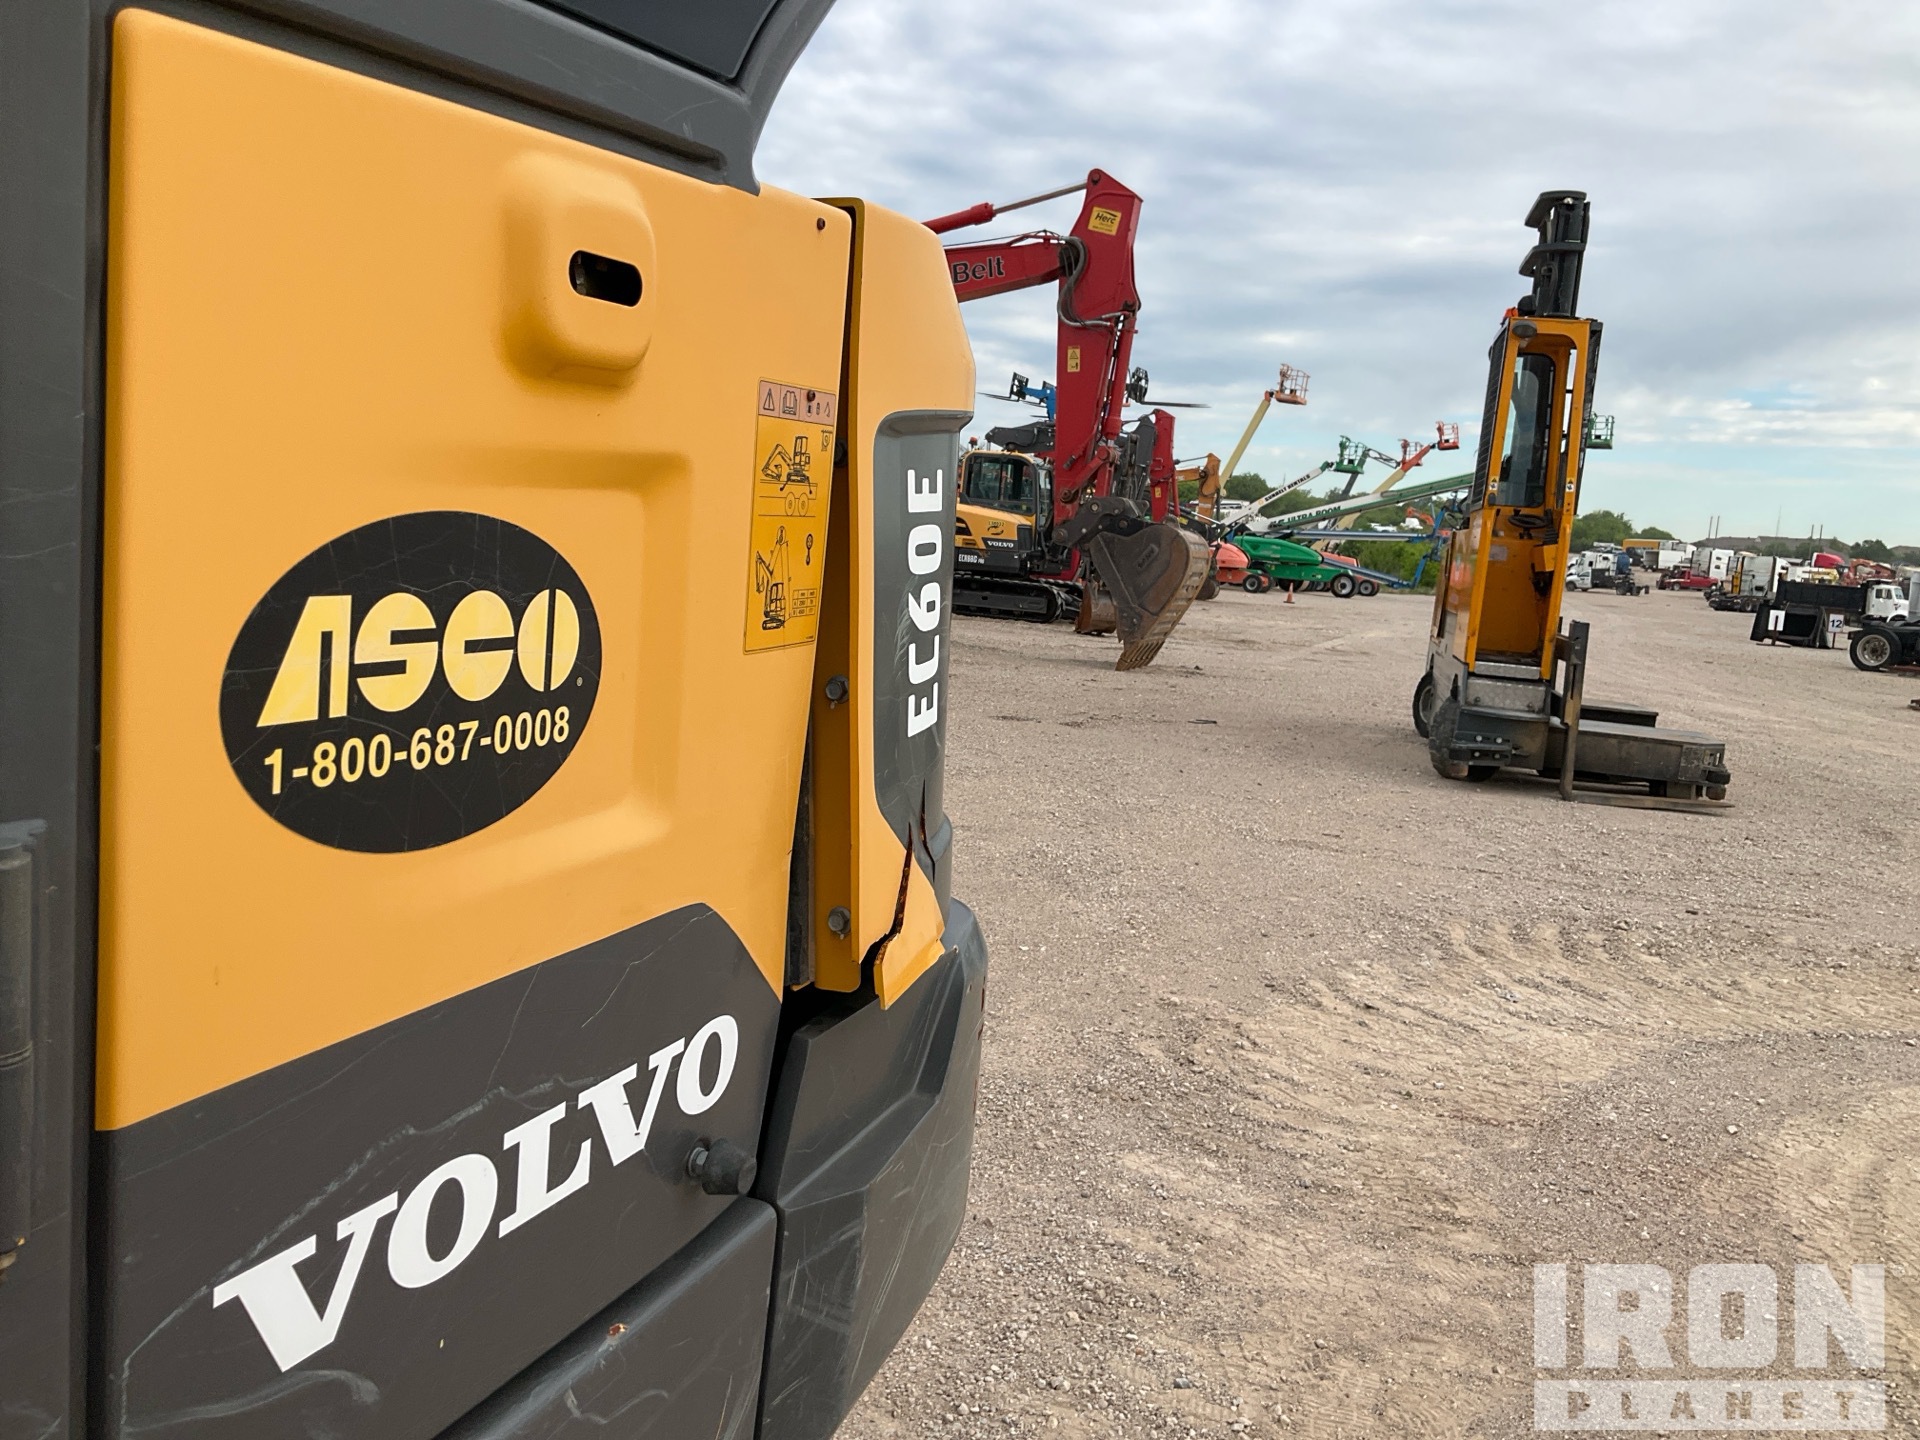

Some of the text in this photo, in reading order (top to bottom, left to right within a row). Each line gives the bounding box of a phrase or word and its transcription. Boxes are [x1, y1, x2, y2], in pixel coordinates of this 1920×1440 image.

[1094, 212, 1116, 224] Herc
[951, 256, 1005, 285] Belt
[987, 540, 1014, 549] VOLVO
[907, 469, 942, 738] EC60E
[1830, 619, 1843, 628] 12
[256, 588, 580, 727] ASCO
[264, 705, 570, 795] 1-800-687-0008
[213, 1014, 739, 1373] VOLVO
